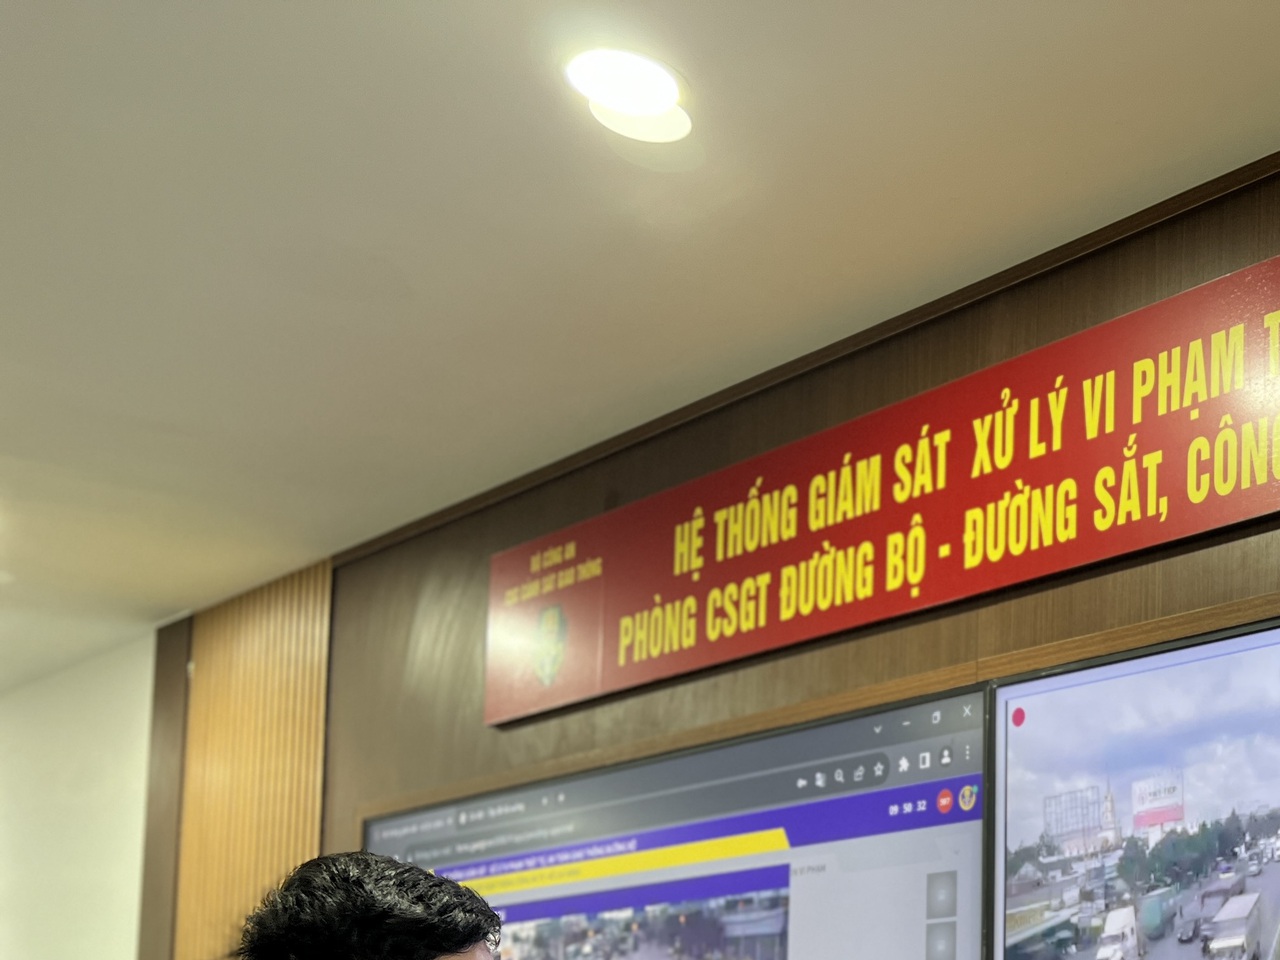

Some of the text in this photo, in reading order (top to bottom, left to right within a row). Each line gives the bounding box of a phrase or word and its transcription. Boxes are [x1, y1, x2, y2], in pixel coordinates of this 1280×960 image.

[618, 594, 697, 667] PHÒNG
[706, 572, 771, 642] CSGT
[779, 540, 874, 622] ĐƯỜNG
[885, 513, 926, 598] BỘ
[938, 543, 951, 559] -
[963, 478, 1077, 570] ĐƯỜNG
[1094, 433, 1168, 531] SẮT,
[674, 506, 705, 581] HỆ
[714, 478, 798, 562] THỐNG
[808, 452, 881, 532] GIÁM
[893, 424, 951, 503] SÁT
[970, 387, 1019, 479] XỬ
[1029, 375, 1068, 460] LÝ
[1083, 370, 1115, 440] VI
[1132, 323, 1244, 425] PHẠM
